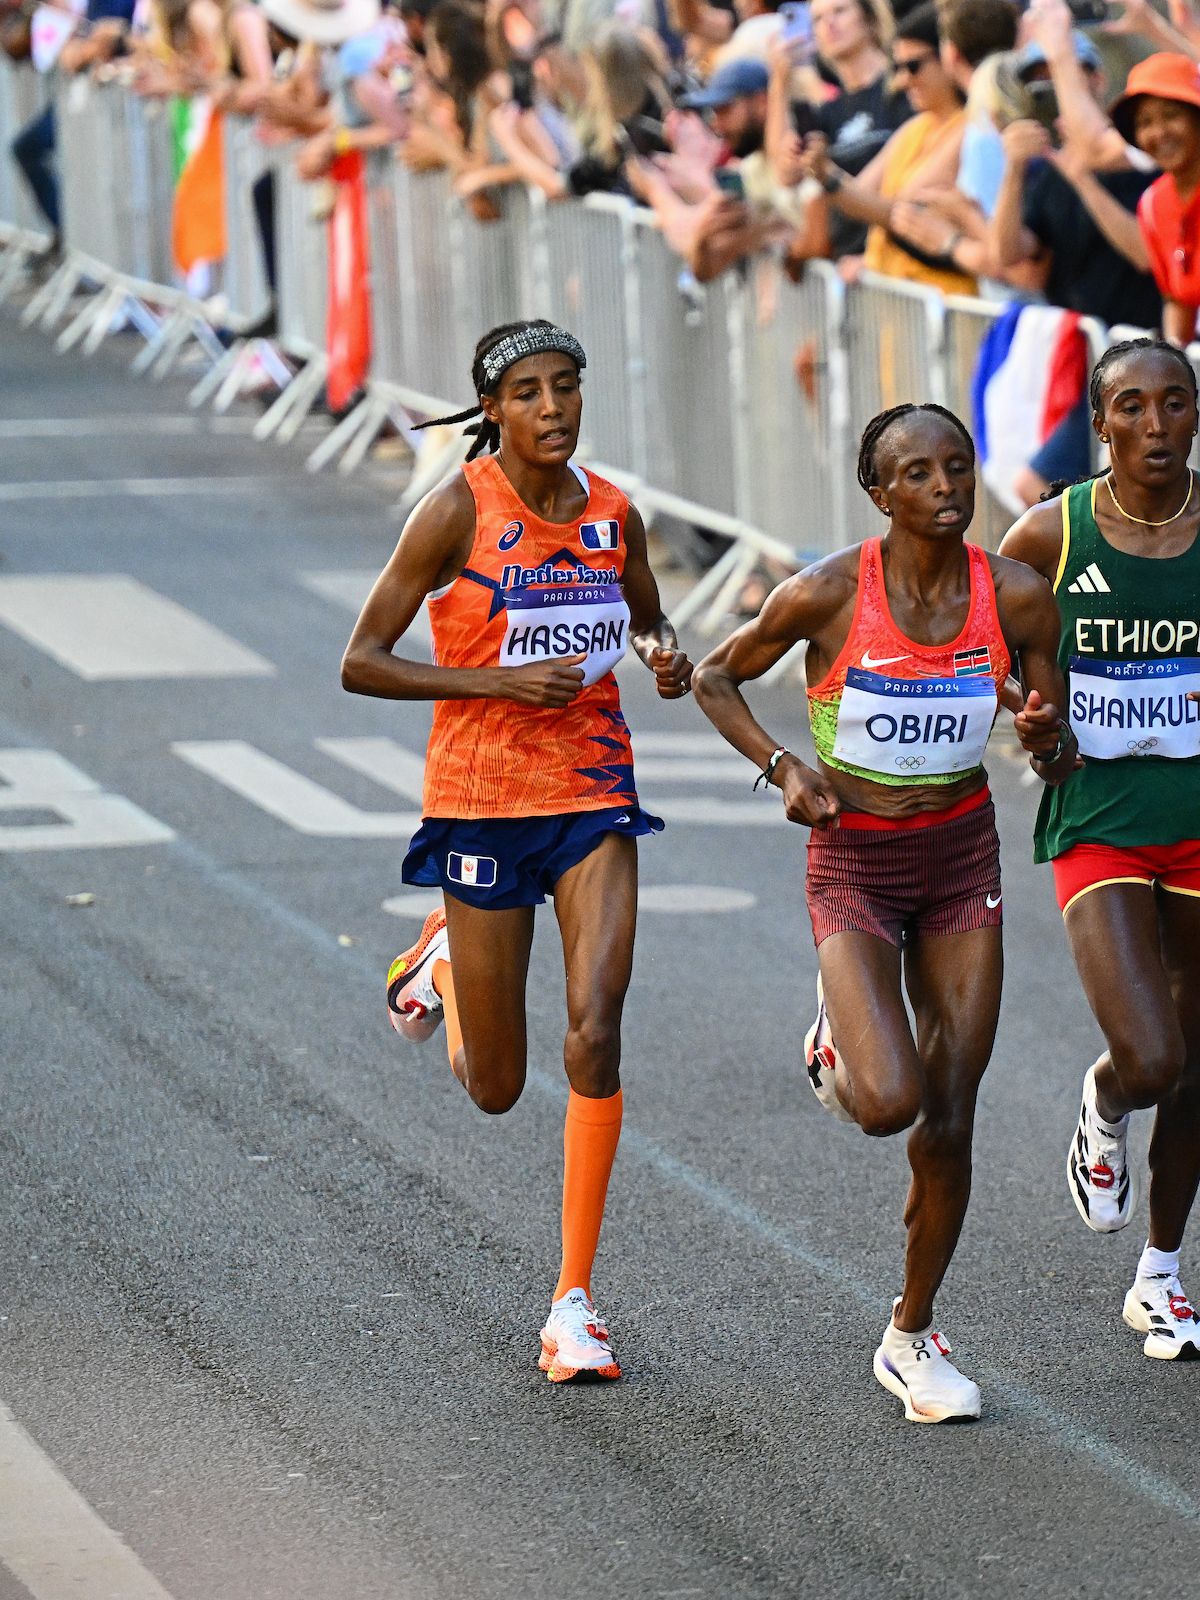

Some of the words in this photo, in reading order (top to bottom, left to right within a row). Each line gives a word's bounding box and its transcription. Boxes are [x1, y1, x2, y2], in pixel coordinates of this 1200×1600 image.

[500, 564, 619, 590] Nederland
[578, 589, 605, 600] 2024
[507, 619, 625, 656] HASSAN
[1147, 663, 1180, 674] 2024
[927, 683, 960, 693] 2024
[865, 713, 968, 744] OBIRI
